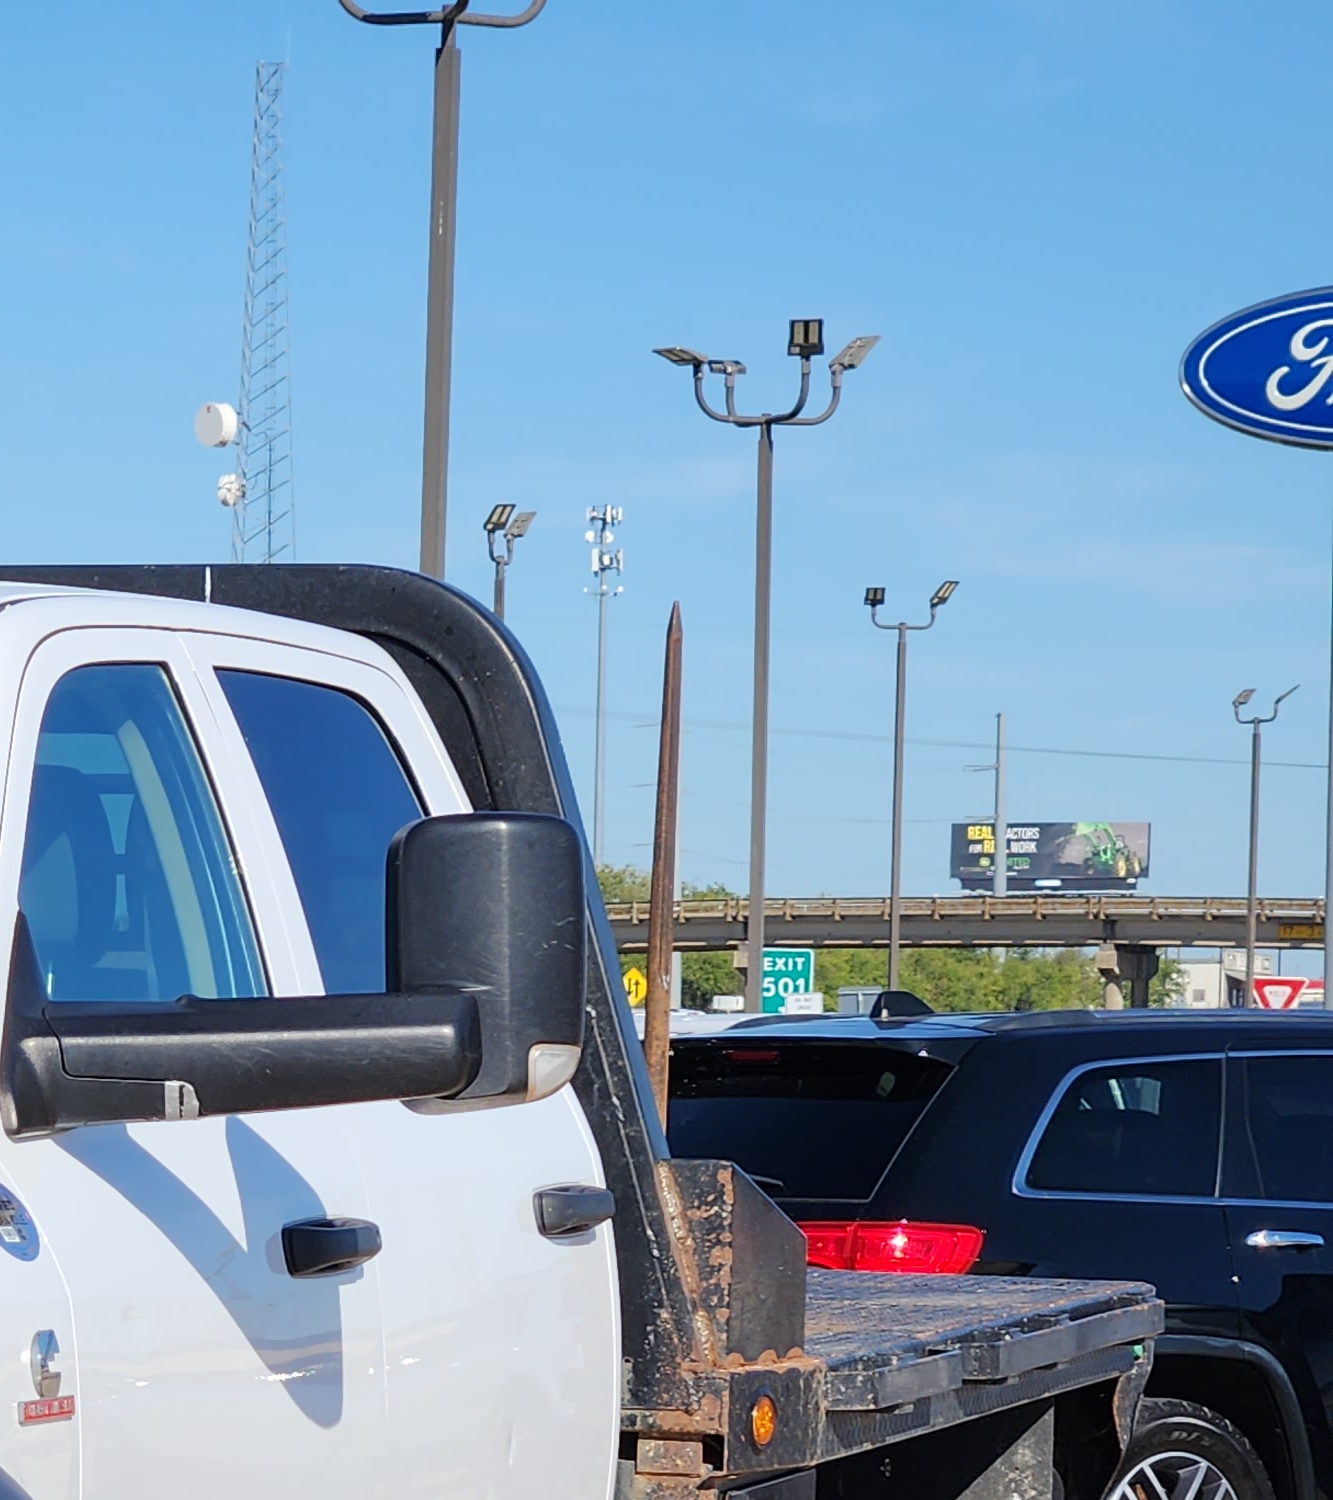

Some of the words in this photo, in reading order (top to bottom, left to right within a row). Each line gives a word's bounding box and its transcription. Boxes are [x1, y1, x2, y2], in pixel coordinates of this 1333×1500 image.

[1005, 827, 1041, 840] ACTORS
[763, 957, 806, 972] EXIT
[762, 977, 806, 997] 501
